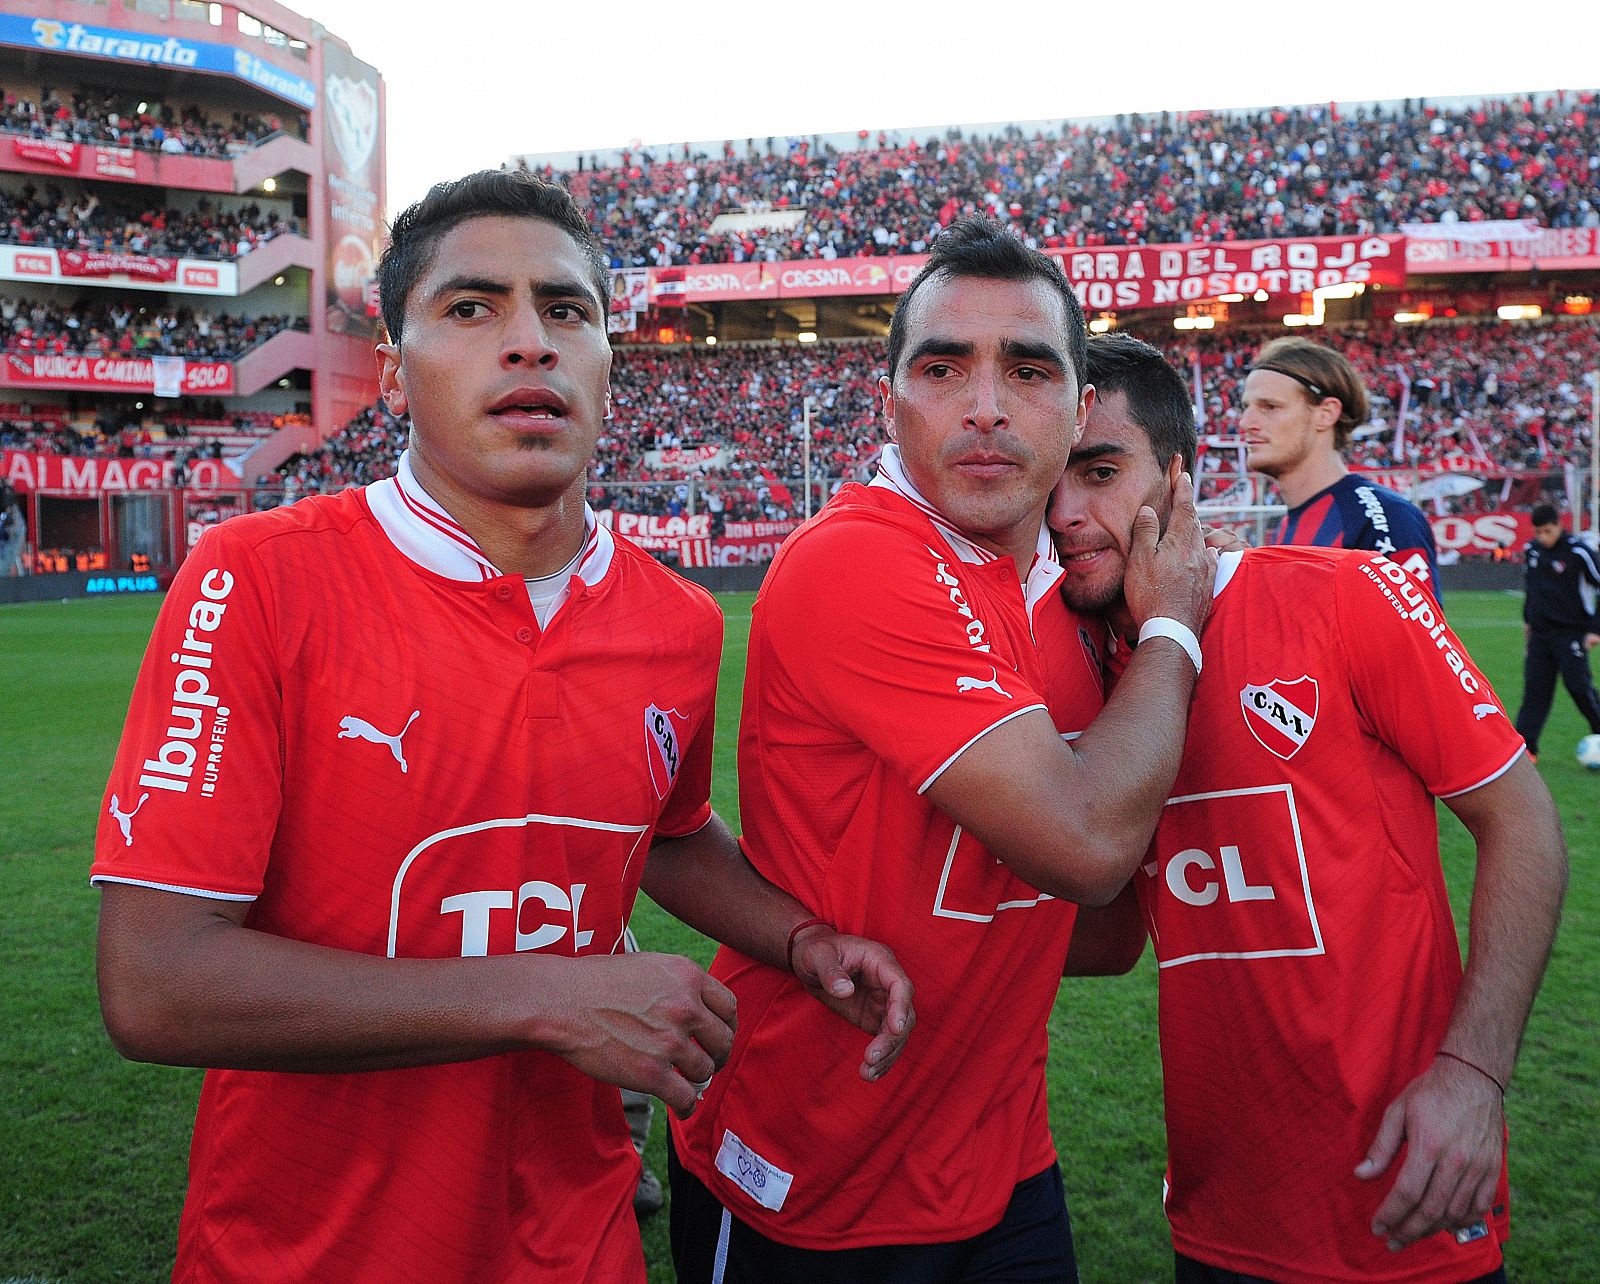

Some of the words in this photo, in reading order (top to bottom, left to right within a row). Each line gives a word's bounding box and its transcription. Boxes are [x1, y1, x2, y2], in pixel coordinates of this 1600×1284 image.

[66, 24, 198, 66] taranto
[250, 62, 315, 104] taranto
[18, 258, 49, 271] TCL
[187, 270, 215, 284] TCL
[1152, 261, 1371, 303] NOSOTROS
[1160, 248, 1238, 277] DEL
[33, 355, 89, 380] NUNCA
[93, 359, 154, 384] CAMINA
[187, 364, 229, 389] SOLO
[619, 511, 711, 537] PILAR
[86, 578, 117, 593] AFA
[117, 575, 158, 593] PLUS
[1358, 564, 1409, 620] IBUPROFENO
[1370, 556, 1479, 694] Ibupirac
[139, 568, 235, 793] Ibupirac
[201, 706, 231, 797] IBUPROFENO
[1144, 845, 1276, 906] CL
[440, 880, 595, 957] TCL
